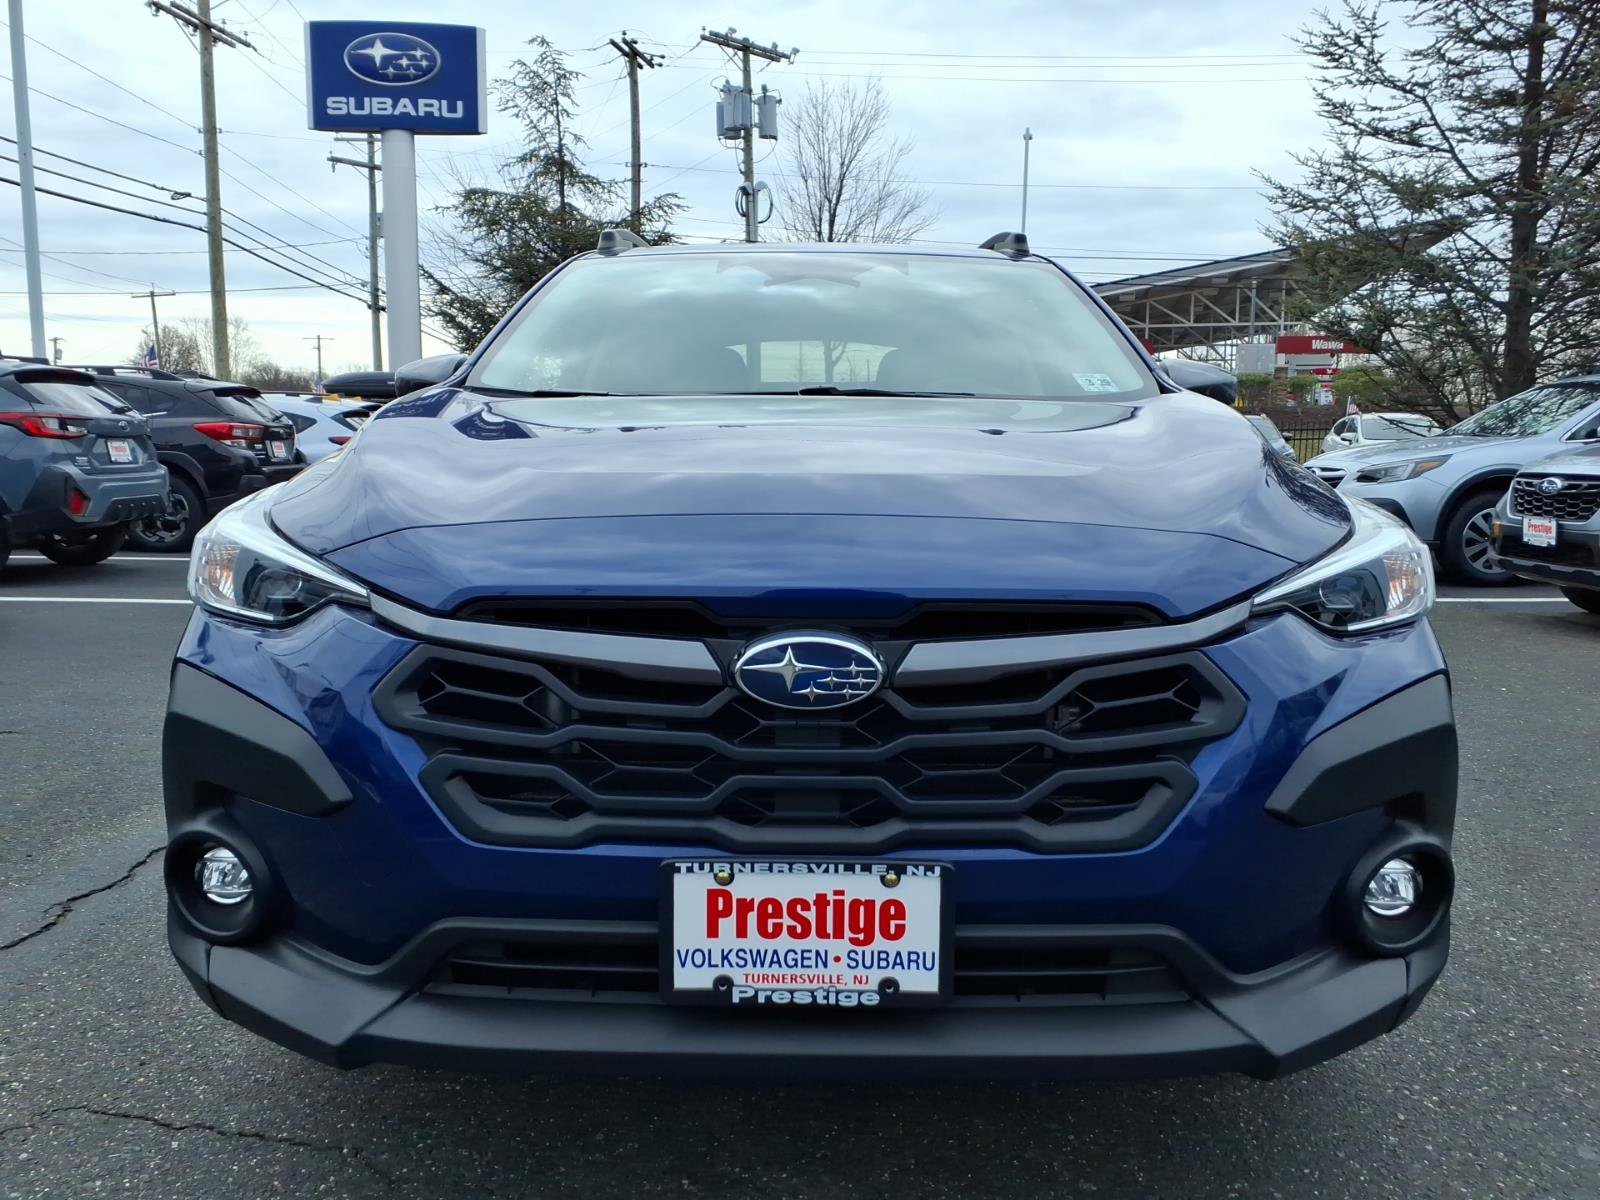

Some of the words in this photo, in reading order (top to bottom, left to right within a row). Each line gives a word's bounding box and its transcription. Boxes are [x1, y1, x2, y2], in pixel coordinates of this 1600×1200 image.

[326, 96, 463, 118] SUBARU
[1312, 339, 1344, 350] Wawa
[906, 864, 941, 878] NJ
[706, 888, 907, 947] Prestige
[676, 948, 829, 969] VOLKSWAGEN
[846, 949, 936, 971] SUBARU
[743, 973, 847, 986] TURNERSVILLE,
[853, 974, 869, 985] NJ
[731, 985, 881, 1007] Prestige
